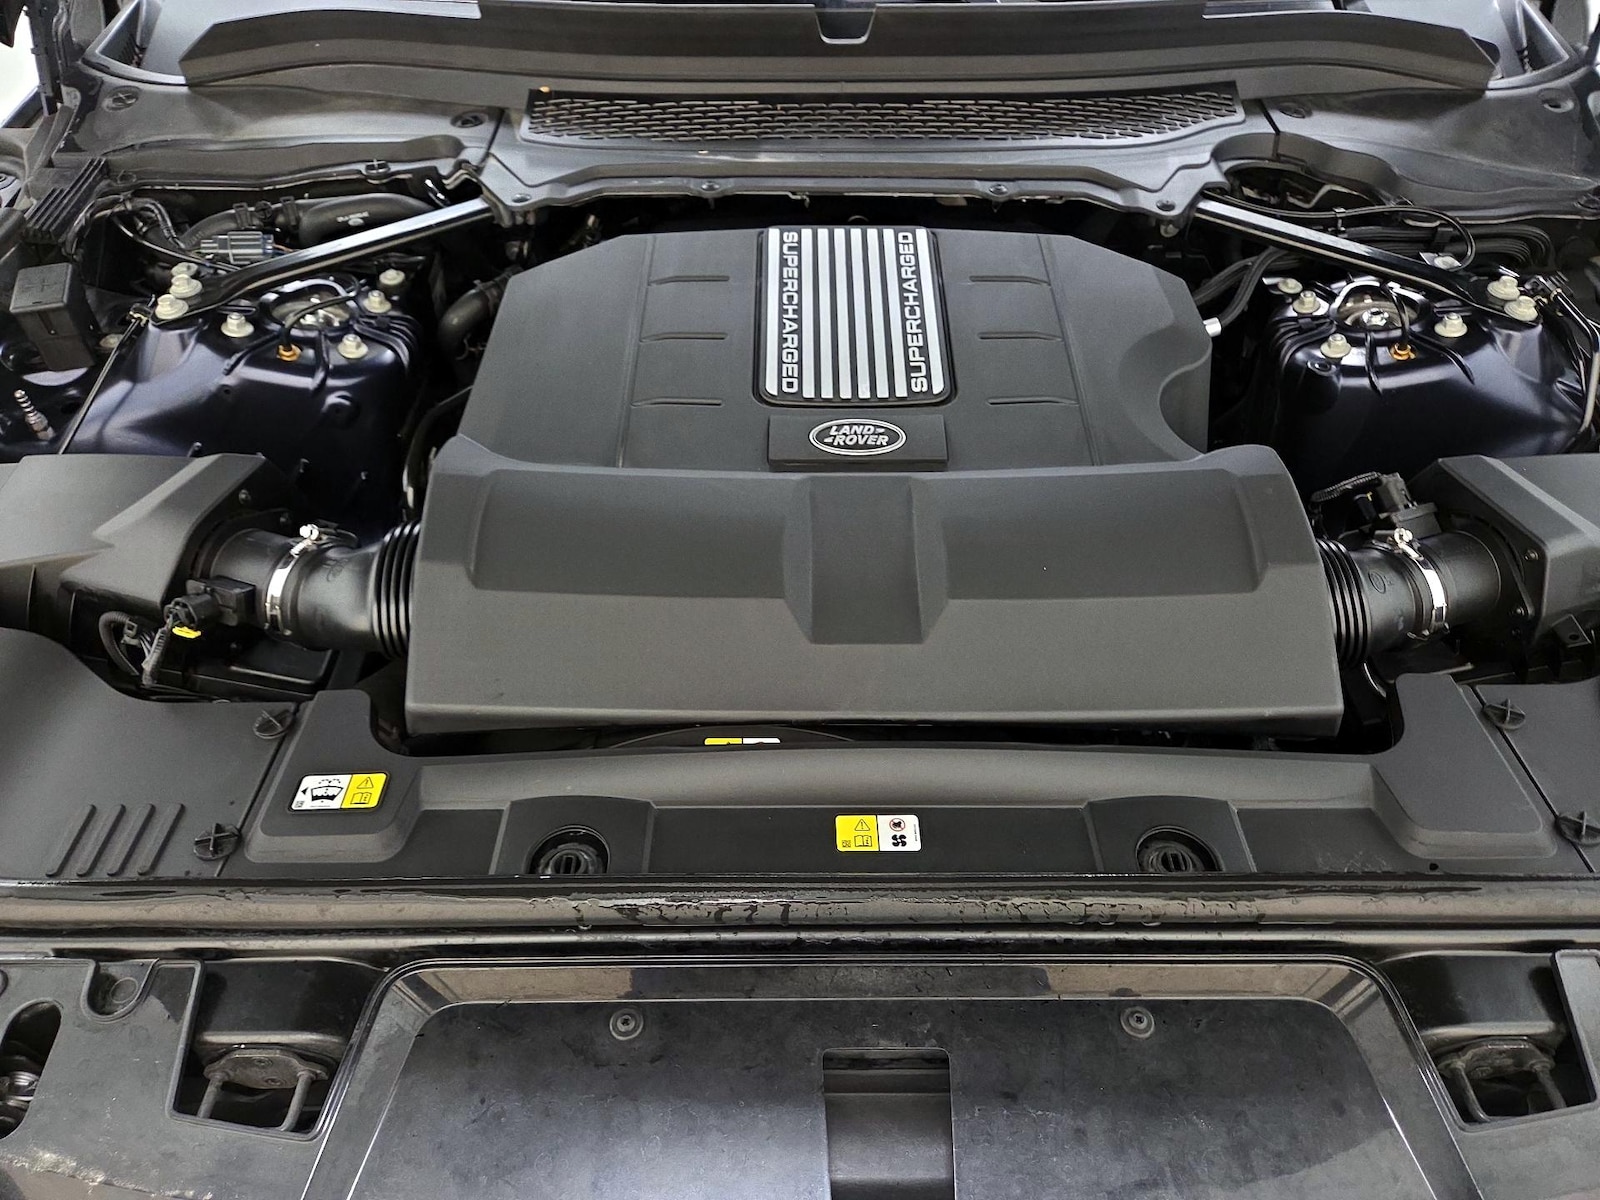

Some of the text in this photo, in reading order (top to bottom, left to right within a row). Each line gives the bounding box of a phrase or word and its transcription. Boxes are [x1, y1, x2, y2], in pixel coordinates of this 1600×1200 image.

[782, 231, 798, 393] SUPERCHARGED
[898, 231, 928, 393] SUPERCHARGED
[829, 425, 875, 436] LAND
[833, 435, 889, 446] ROVER
